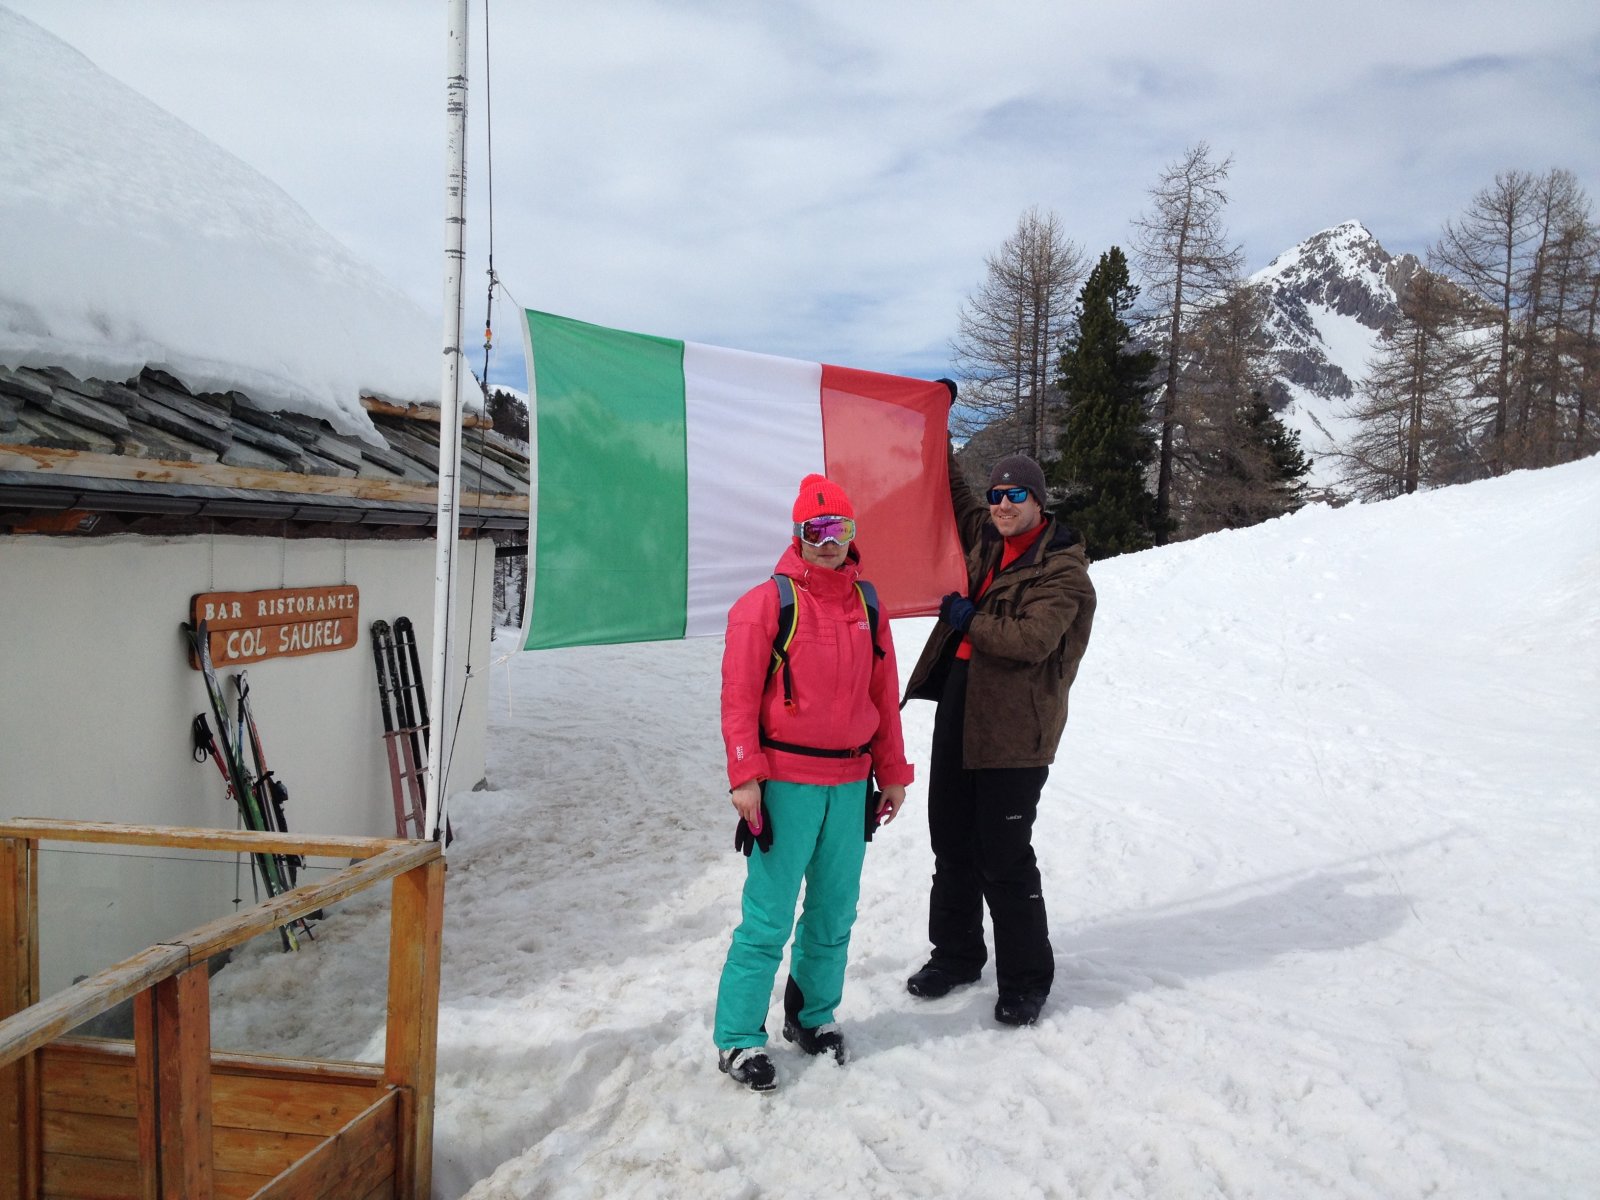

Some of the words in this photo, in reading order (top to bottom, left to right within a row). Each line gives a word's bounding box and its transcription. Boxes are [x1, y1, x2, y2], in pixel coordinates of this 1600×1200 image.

[205, 601, 242, 621] BAR
[257, 594, 354, 617] RISTORANTE
[227, 628, 267, 659] COL
[278, 620, 343, 653] SAUREL
